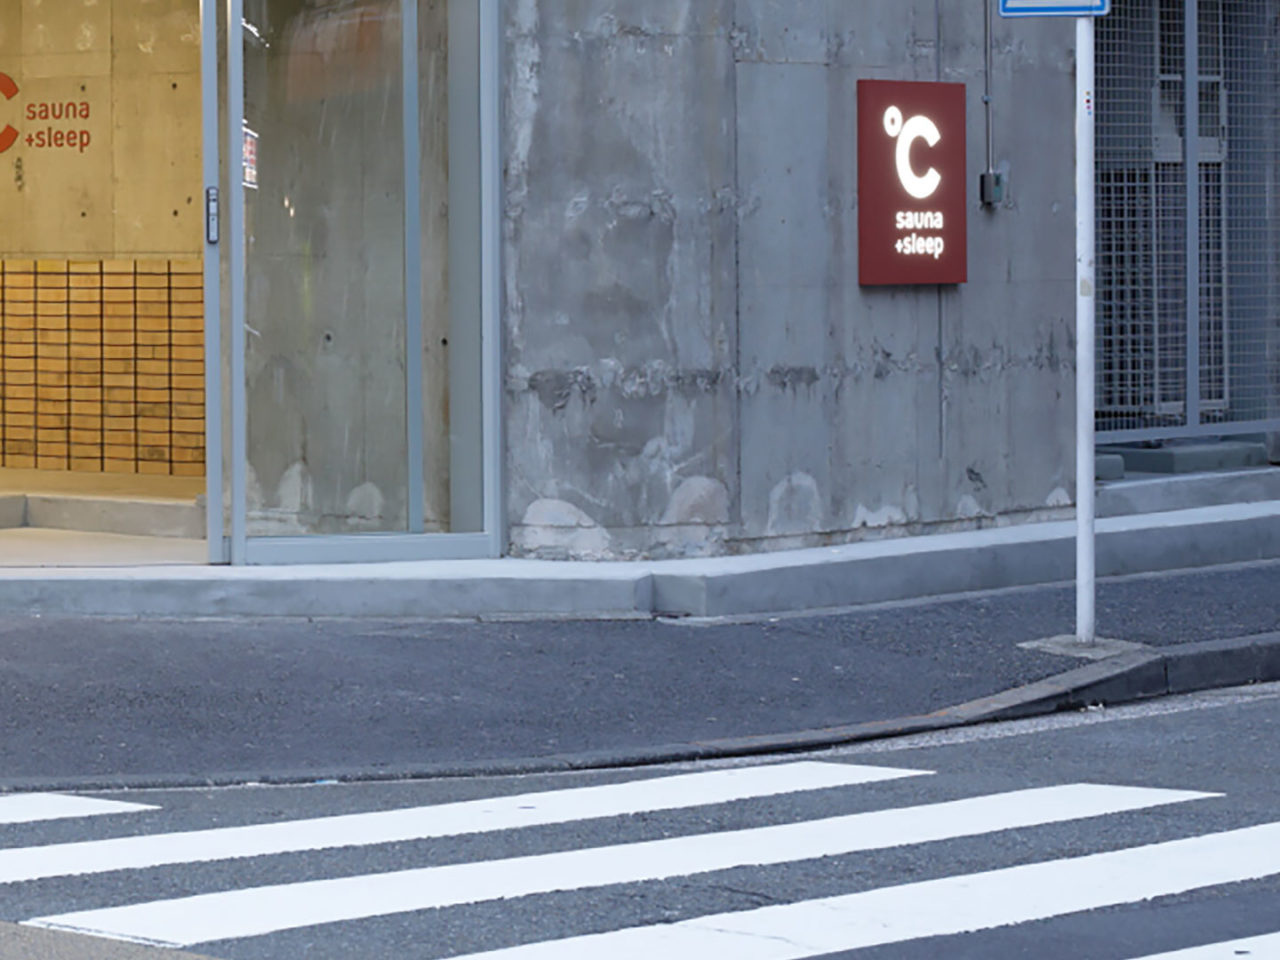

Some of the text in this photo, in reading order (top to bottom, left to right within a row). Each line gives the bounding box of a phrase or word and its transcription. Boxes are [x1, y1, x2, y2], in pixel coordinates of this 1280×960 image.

[26, 102, 90, 120] sauna
[25, 127, 91, 153] +sleep
[895, 211, 944, 229] sauna
[894, 233, 945, 260] +sleep
